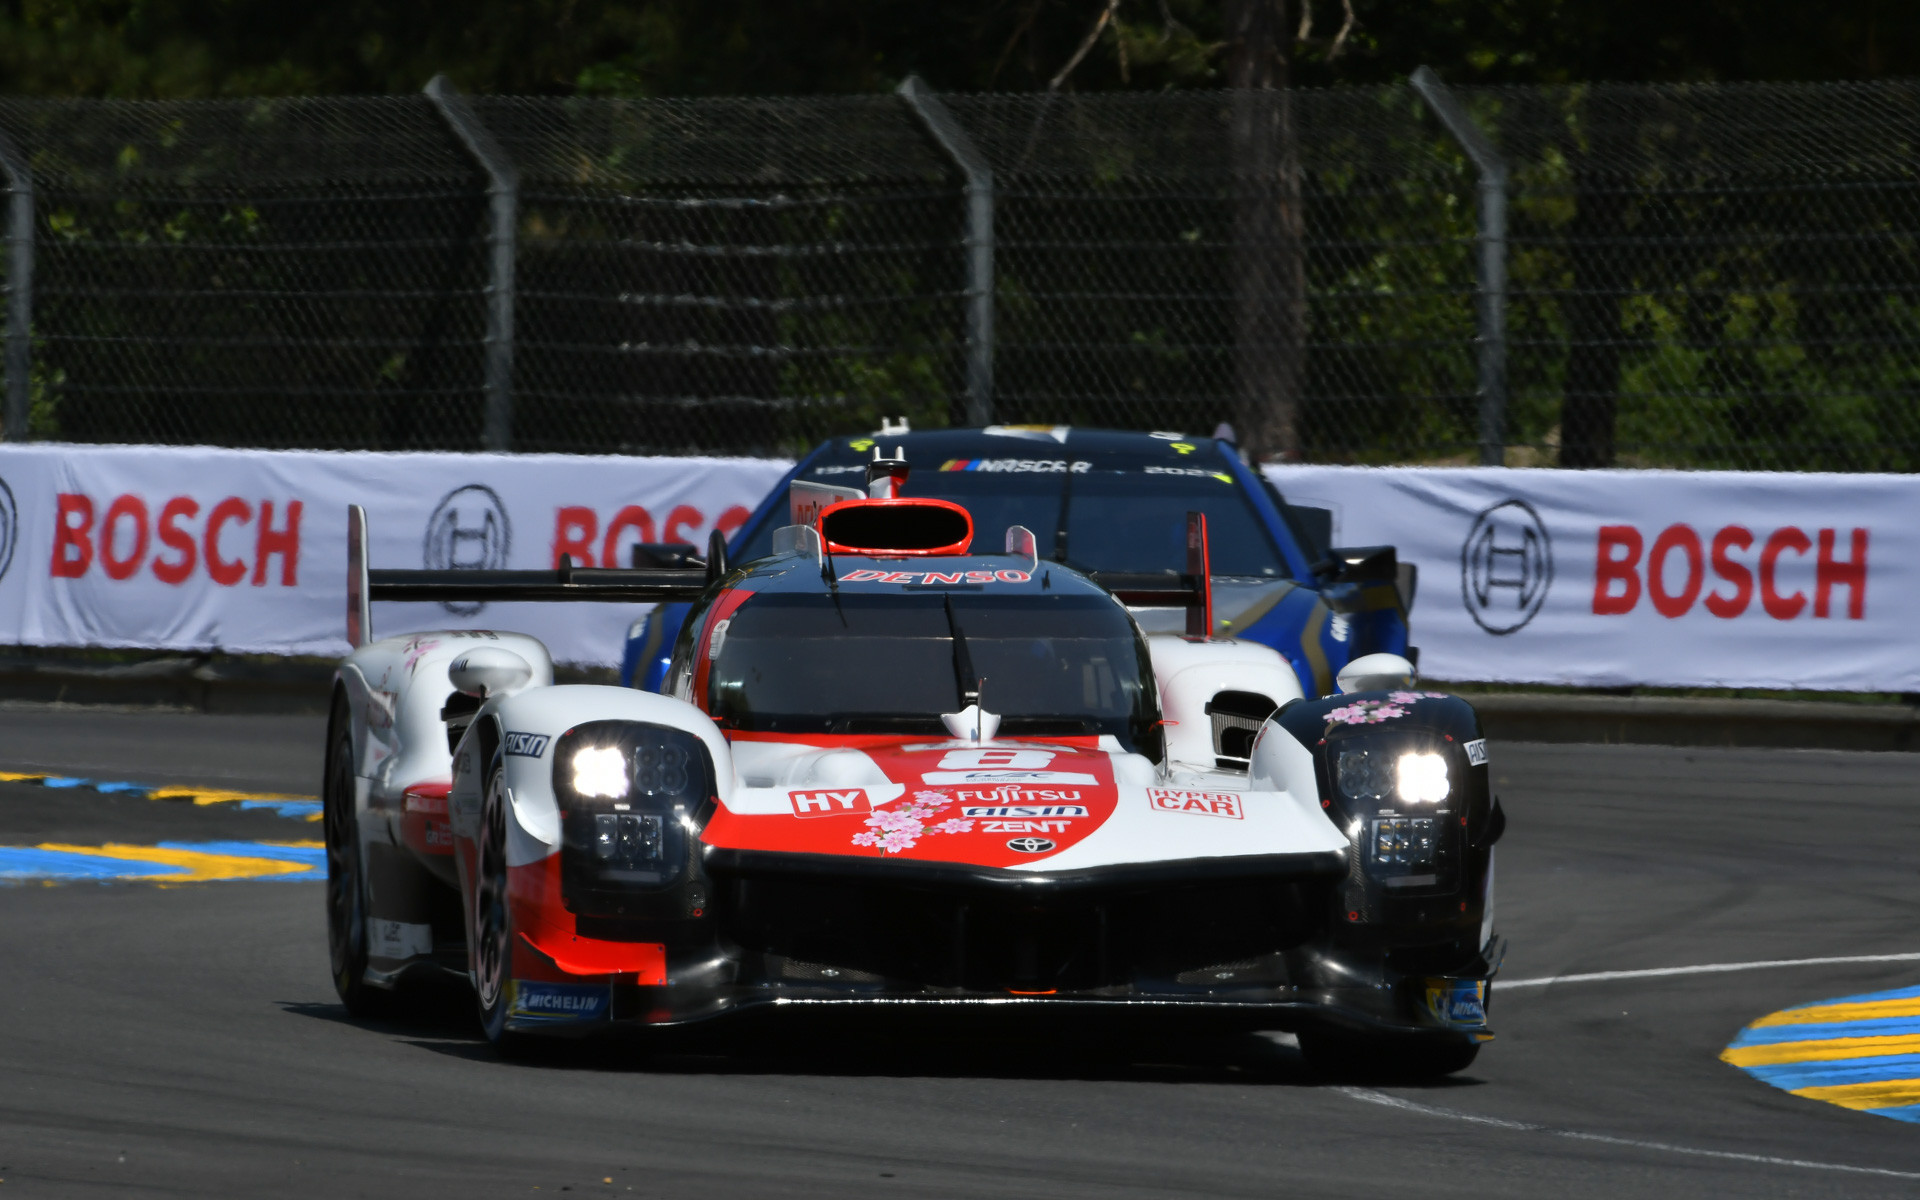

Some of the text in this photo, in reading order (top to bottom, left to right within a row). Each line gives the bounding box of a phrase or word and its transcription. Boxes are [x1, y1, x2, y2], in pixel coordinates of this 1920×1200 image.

[977, 459, 1093, 474] NASCAR
[51, 493, 303, 587] BOSCH
[838, 569, 1032, 584] DENSO
[1593, 523, 1870, 620] BOSCH
[505, 733, 548, 756] AISIN
[937, 750, 1056, 769] 8
[794, 791, 860, 812] HY
[957, 785, 1081, 804] FUJITSU
[1154, 790, 1232, 802] HYPER
[966, 807, 1083, 816] AISIN
[1156, 797, 1235, 816] CAR
[980, 820, 1072, 833] ZENT
[528, 994, 599, 1010] MICHELIN
